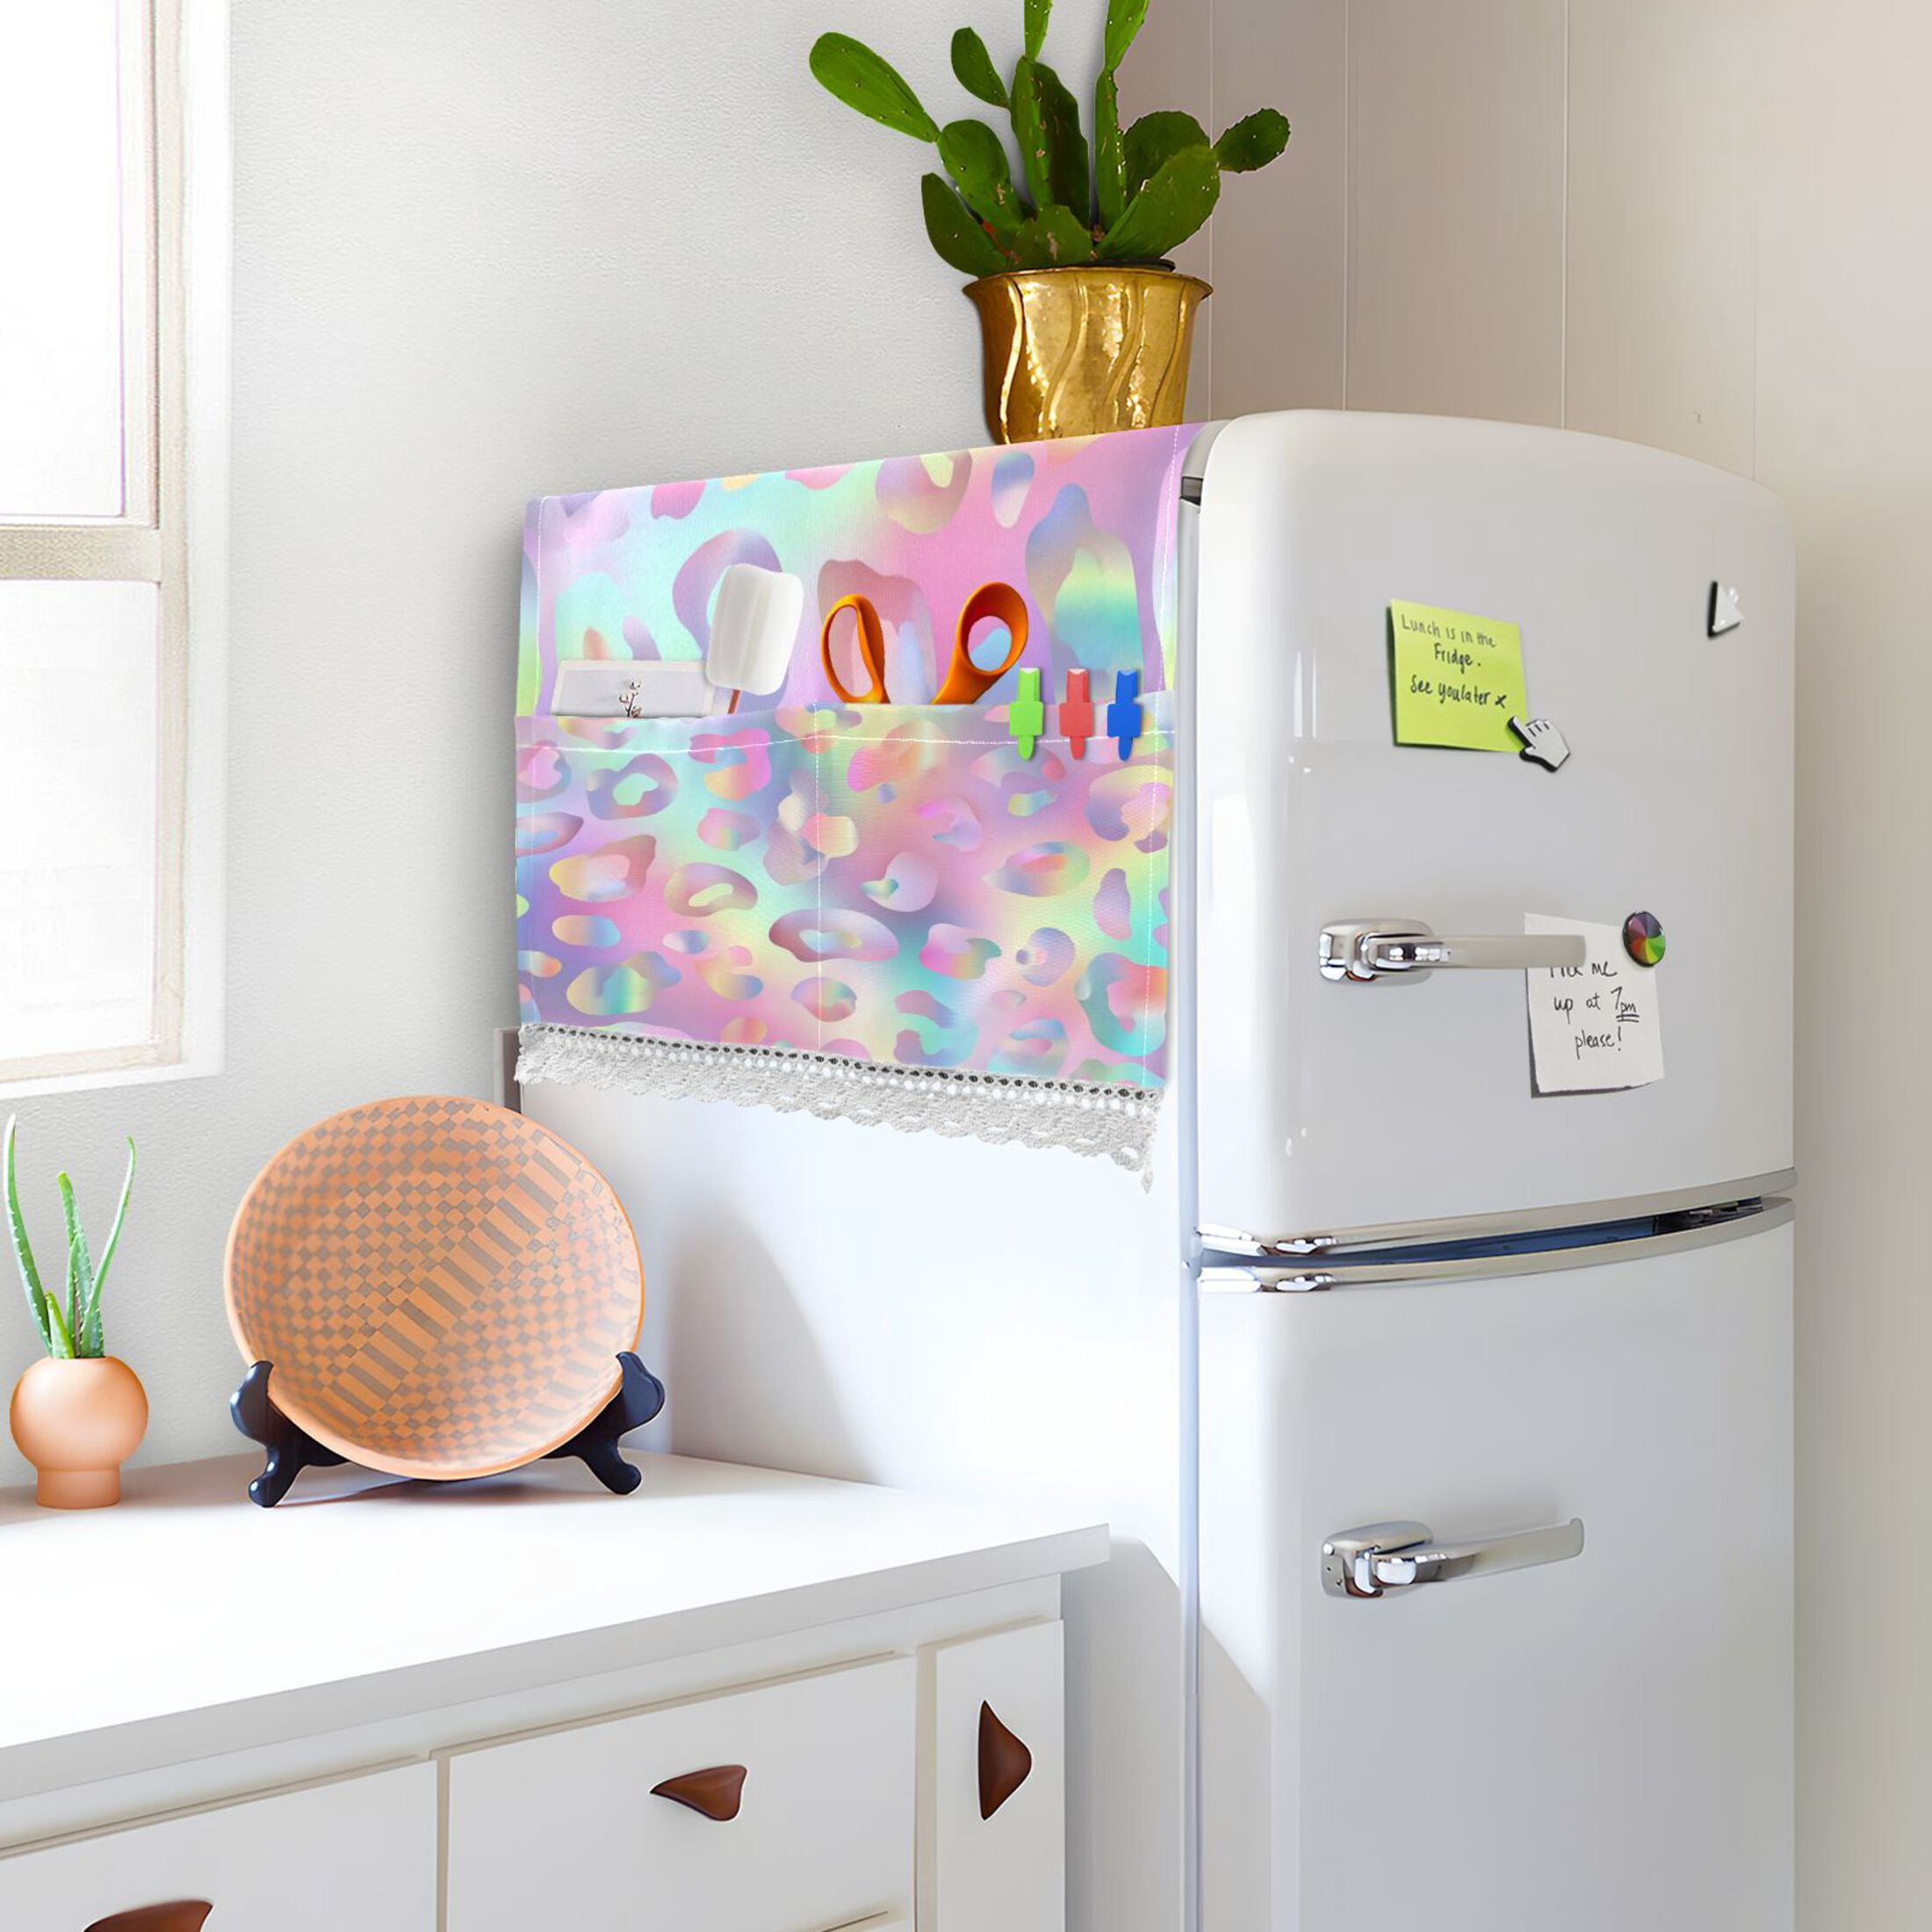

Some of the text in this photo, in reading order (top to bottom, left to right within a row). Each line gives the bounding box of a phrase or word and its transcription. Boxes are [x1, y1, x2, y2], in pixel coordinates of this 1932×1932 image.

[1401, 613, 1441, 639] Lunch
[1460, 630, 1474, 644] in
[1476, 631, 1496, 648] the
[1410, 674, 1433, 695] See
[1554, 996, 1574, 1025] up
[1585, 991, 1601, 1011] at
[1575, 1025, 1622, 1061] please!
